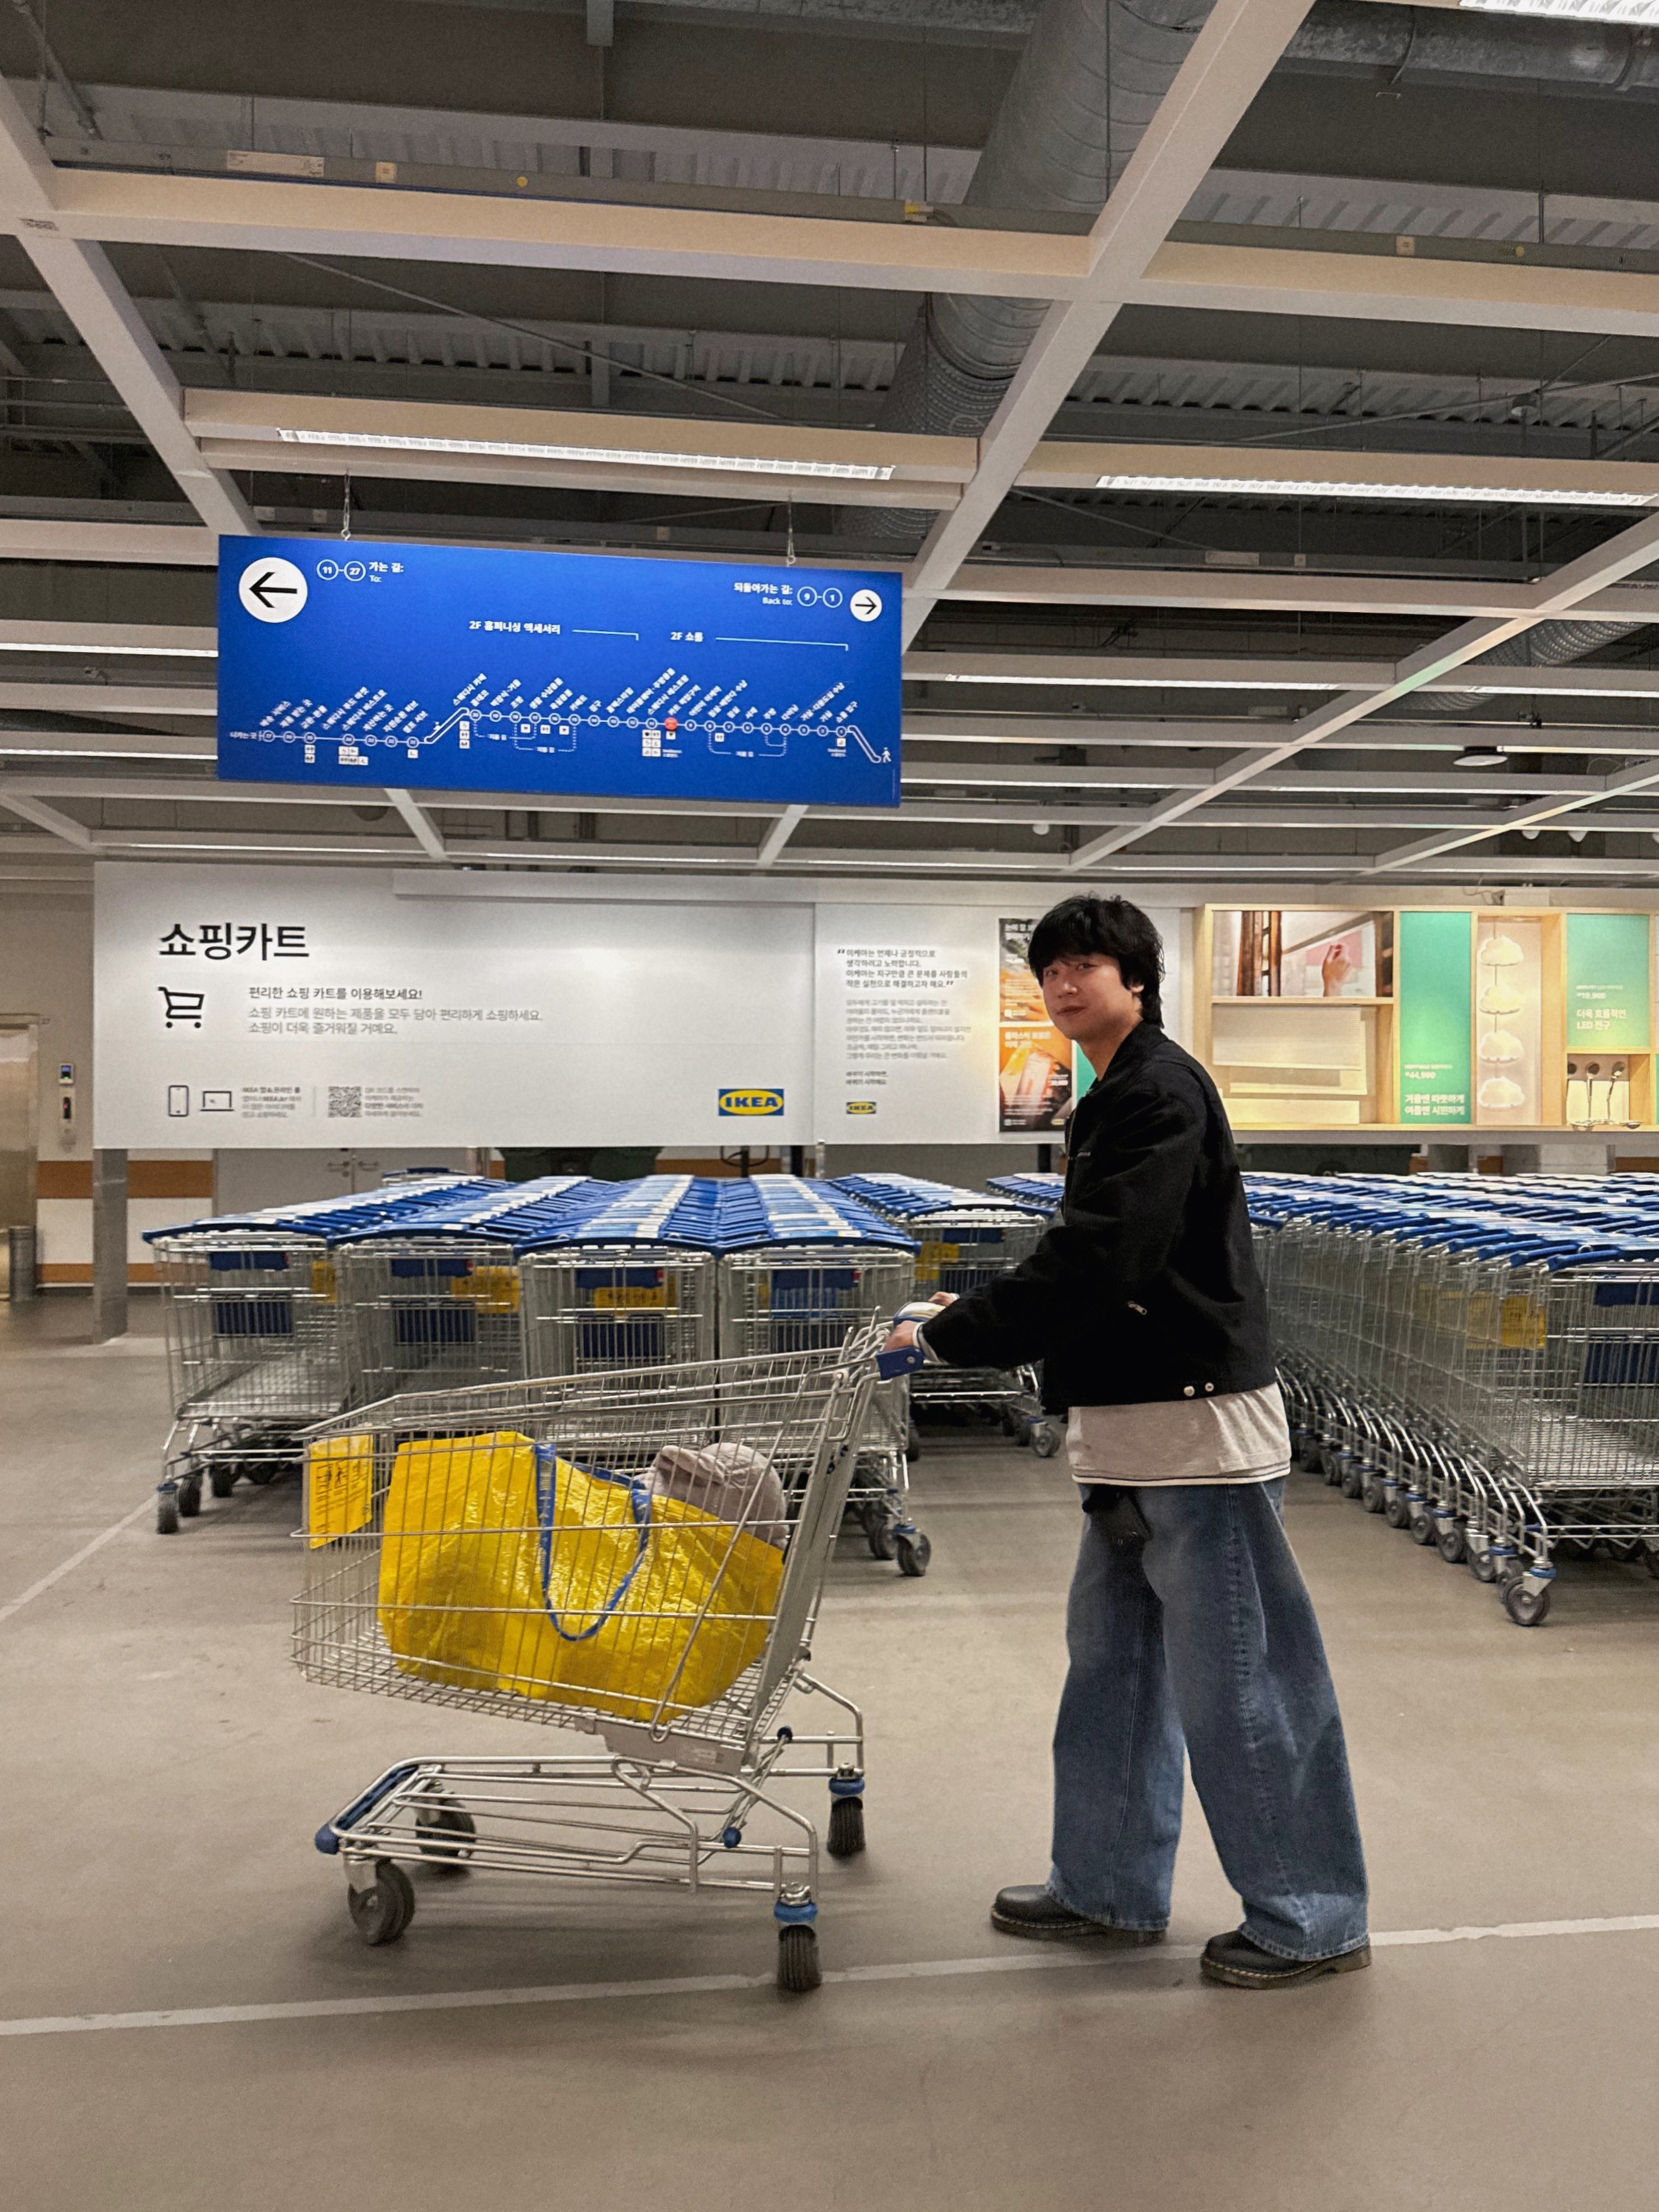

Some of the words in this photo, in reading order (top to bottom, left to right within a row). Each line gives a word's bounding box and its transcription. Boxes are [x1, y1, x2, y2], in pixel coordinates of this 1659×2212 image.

[369, 561, 388, 573] 가는
[734, 582, 779, 595] 되돌아가는
[781, 585, 793, 595] 길:
[762, 597, 781, 605] Back
[469, 620, 482, 629] 2F
[484, 620, 521, 632] 홈퍼니싱
[670, 632, 683, 640] 2F
[685, 632, 703, 643] 쇼룸
[158, 923, 310, 961] 쇼핑카트
[876, 950, 899, 958] 언제나
[900, 950, 936, 958] 긍정적으로
[846, 970, 875, 978] 이케아는
[248, 986, 283, 999] 편리한
[286, 987, 310, 999] 쇼핑
[313, 987, 347, 1000] 카트를
[351, 988, 422, 1001] 이용해보세요!
[248, 1007, 272, 1019] 쇼핑
[276, 1008, 310, 1020] 카트에
[313, 1008, 347, 1020] 원하는
[351, 1008, 385, 1020] 제품을
[388, 1009, 410, 1020] 모두
[414, 1008, 436, 1020] 담아
[439, 1009, 483, 1021] 편리하게
[486, 1010, 544, 1021] 쇼핑하세요.
[1576, 1009, 1593, 1019] 더욱
[1595, 1009, 1627, 1020] 효율적인
[248, 1022, 282, 1034] 쇼핑이
[286, 1022, 310, 1034] 더욱
[313, 1022, 358, 1035] 즐거워질
[1576, 1021, 1593, 1030] LED
[1594, 1020, 1611, 1031] 전구
[725, 1097, 778, 1107] IKEA
[1404, 1105, 1431, 1115] 여름엔
[1431, 1105, 1465, 1115] 시원하게
